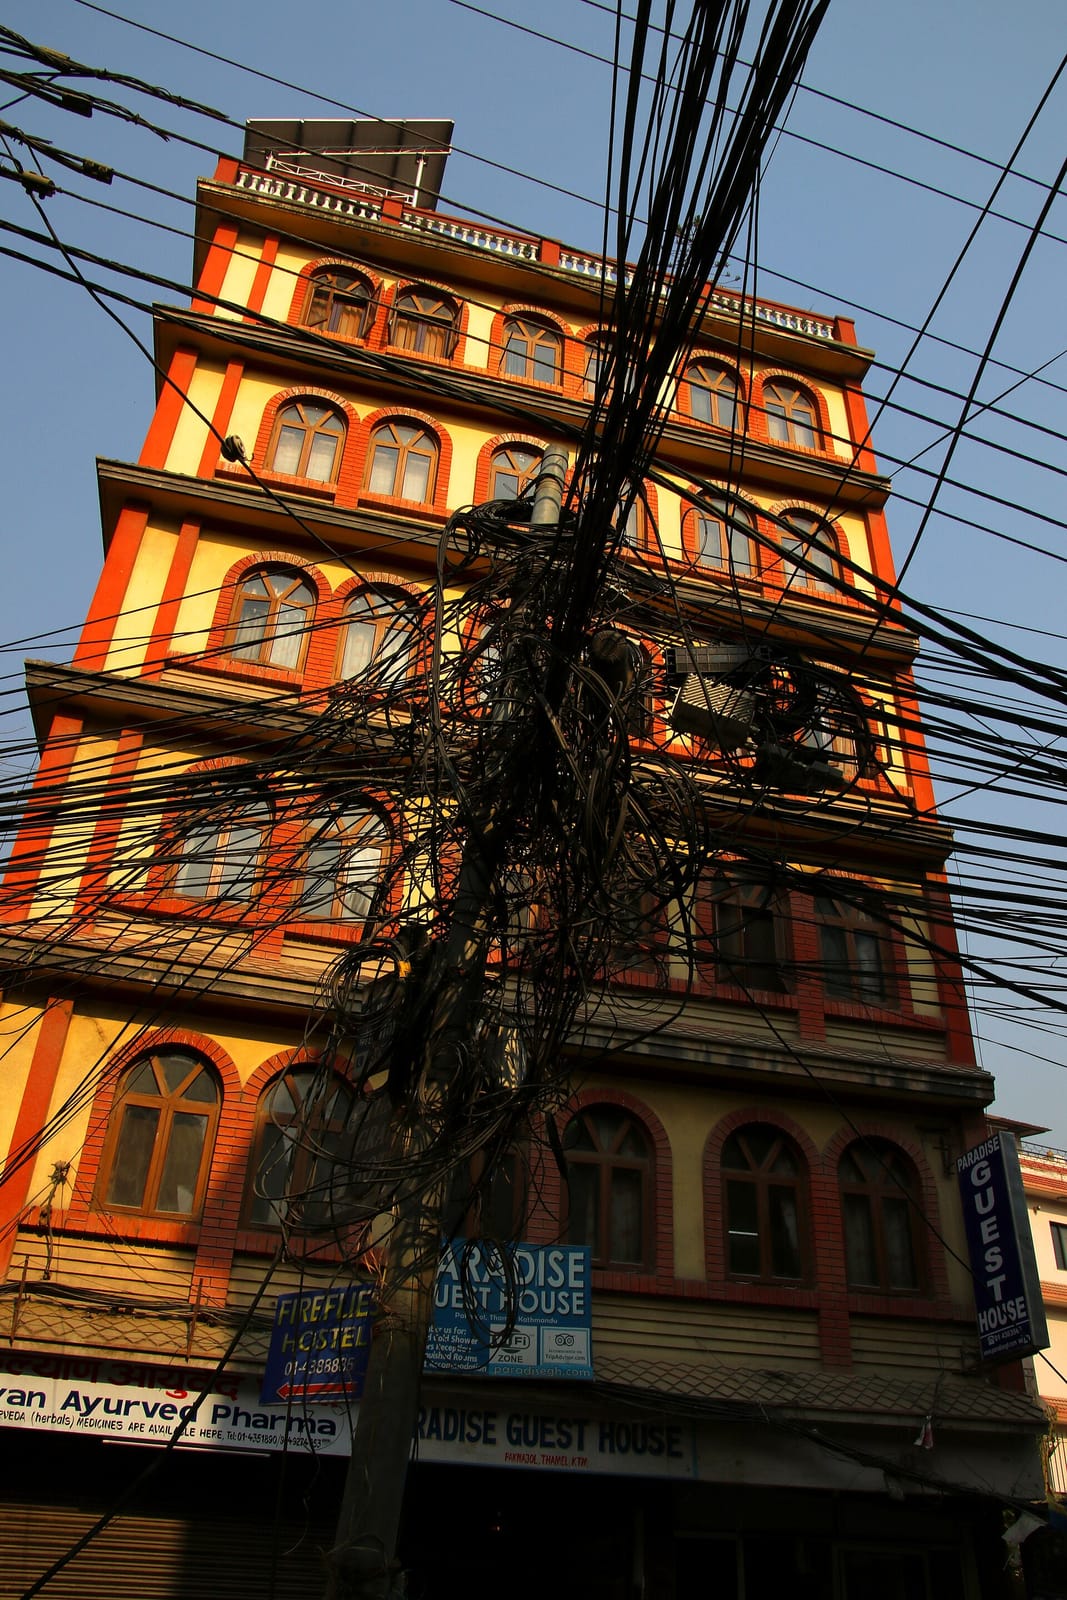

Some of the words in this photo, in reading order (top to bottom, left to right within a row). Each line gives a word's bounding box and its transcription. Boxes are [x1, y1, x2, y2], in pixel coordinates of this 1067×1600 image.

[956, 1135, 1000, 1172] PARADISE
[970, 1160, 1007, 1302] GUEST
[436, 1242, 585, 1289] ARADISE
[277, 1289, 379, 1326] FIREFLIES
[434, 1283, 491, 1310] UEST
[499, 1288, 585, 1315] HOUSE
[978, 1296, 1027, 1333] HOUSE
[518, 1315, 558, 1324] Kathmandu
[281, 1325, 368, 1353] HOSTEL
[451, 1335, 479, 1345] Shower
[498, 1354, 523, 1363] ZONE
[0, 1388, 46, 1408] an
[60, 1391, 197, 1422] Ayurved
[211, 1404, 336, 1436] Pharma
[31, 1411, 74, 1429] (herbals)
[77, 1417, 123, 1430] MEDICINES
[128, 1422, 145, 1432] ARE
[148, 1424, 196, 1437] AVAILLE
[418, 1407, 497, 1445] RADISE
[506, 1413, 590, 1451] GUEST
[598, 1422, 684, 1457] HOUSE
